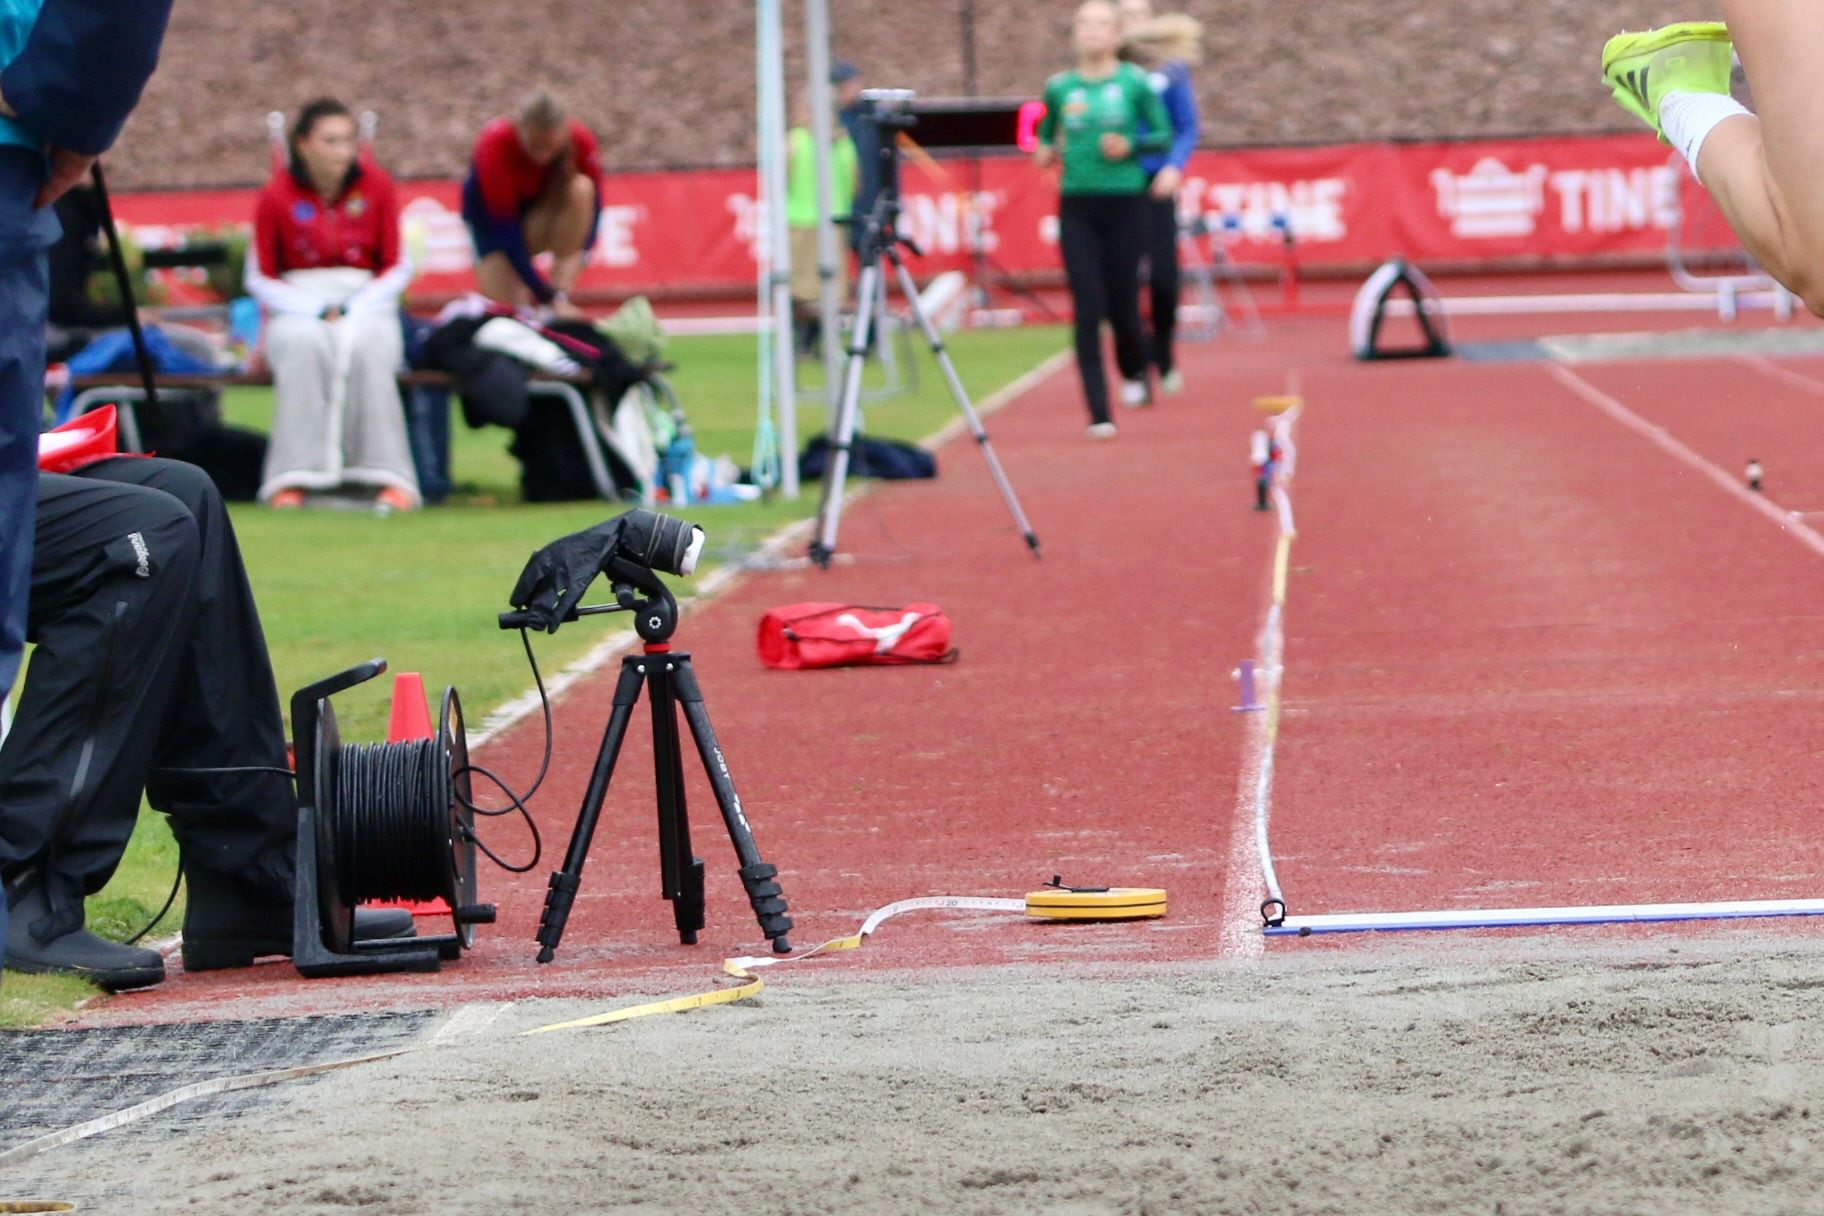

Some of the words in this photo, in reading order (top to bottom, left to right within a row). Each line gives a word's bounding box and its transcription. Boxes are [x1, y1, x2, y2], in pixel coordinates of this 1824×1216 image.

[1208, 177, 1348, 243] TINE
[1551, 166, 1680, 232] TINE
[713, 746, 730, 779] JOBY
